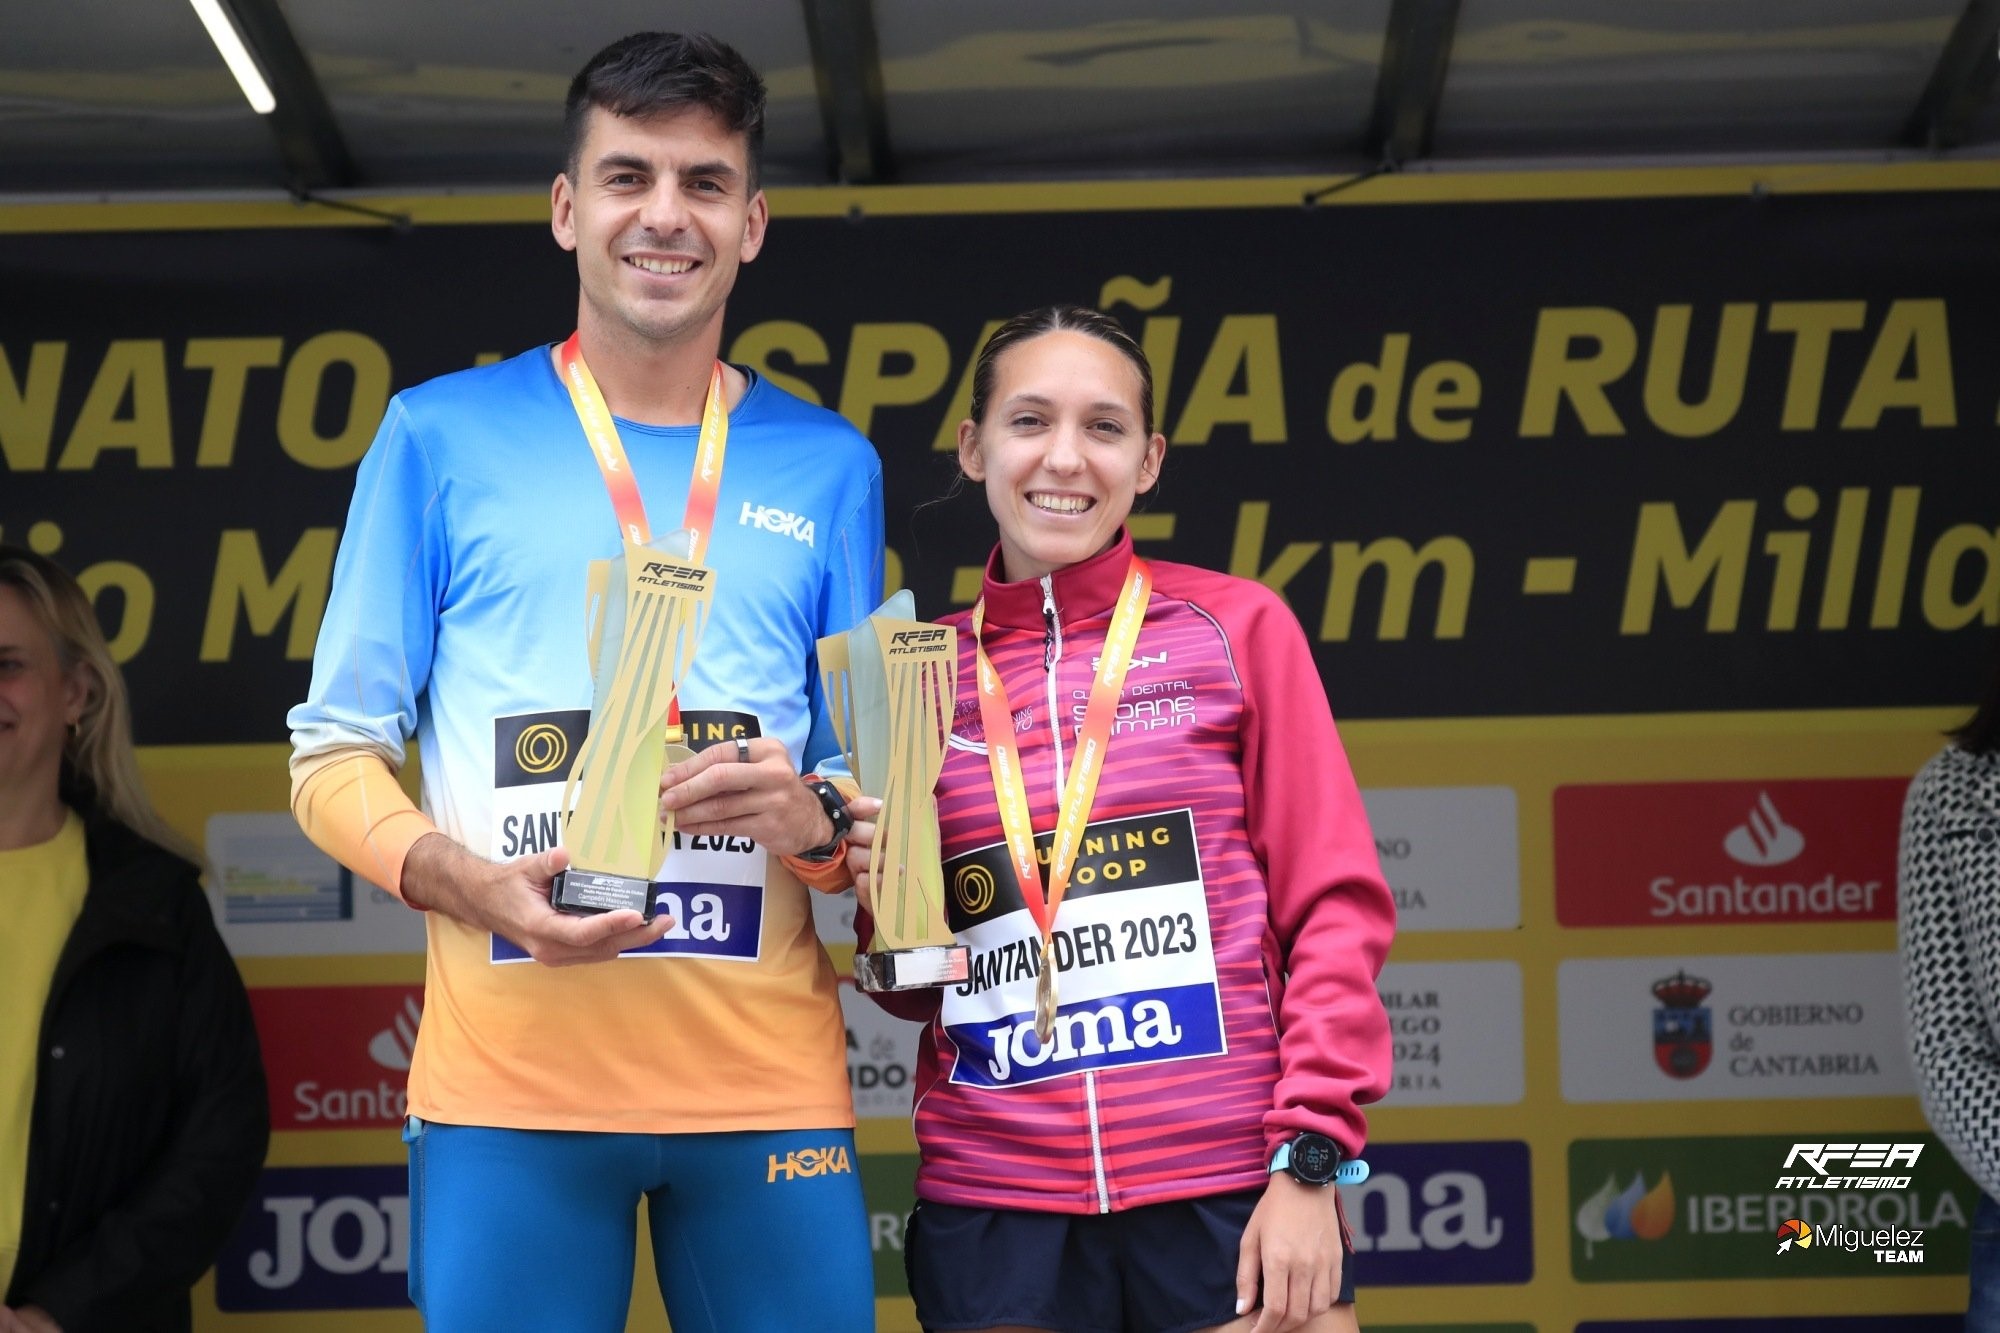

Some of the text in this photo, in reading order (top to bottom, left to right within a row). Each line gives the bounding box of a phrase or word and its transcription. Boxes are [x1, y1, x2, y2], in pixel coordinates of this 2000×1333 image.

[1327, 334, 1481, 444] de
[1518, 299, 1957, 438] RUTA
[739, 501, 815, 549] HOKA
[642, 562, 708, 581] RFEA
[637, 576, 704, 592] ATLETISMO
[892, 629, 947, 646] RFEA
[889, 645, 948, 655] ATLETISMO
[1132, 680, 1193, 696] DENTAL
[1073, 696, 1196, 721] SOANE
[1065, 859, 1146, 888] OOP
[1651, 875, 1881, 916] Santander
[1120, 913, 1197, 960] 2023
[1728, 1002, 1864, 1026] GOBIERNO
[1730, 1032, 1753, 1050] de
[1729, 1055, 1879, 1077] CANTABRIA
[767, 1146, 852, 1183] HOKA
[1686, 1191, 1968, 1234] IBERDROLA
